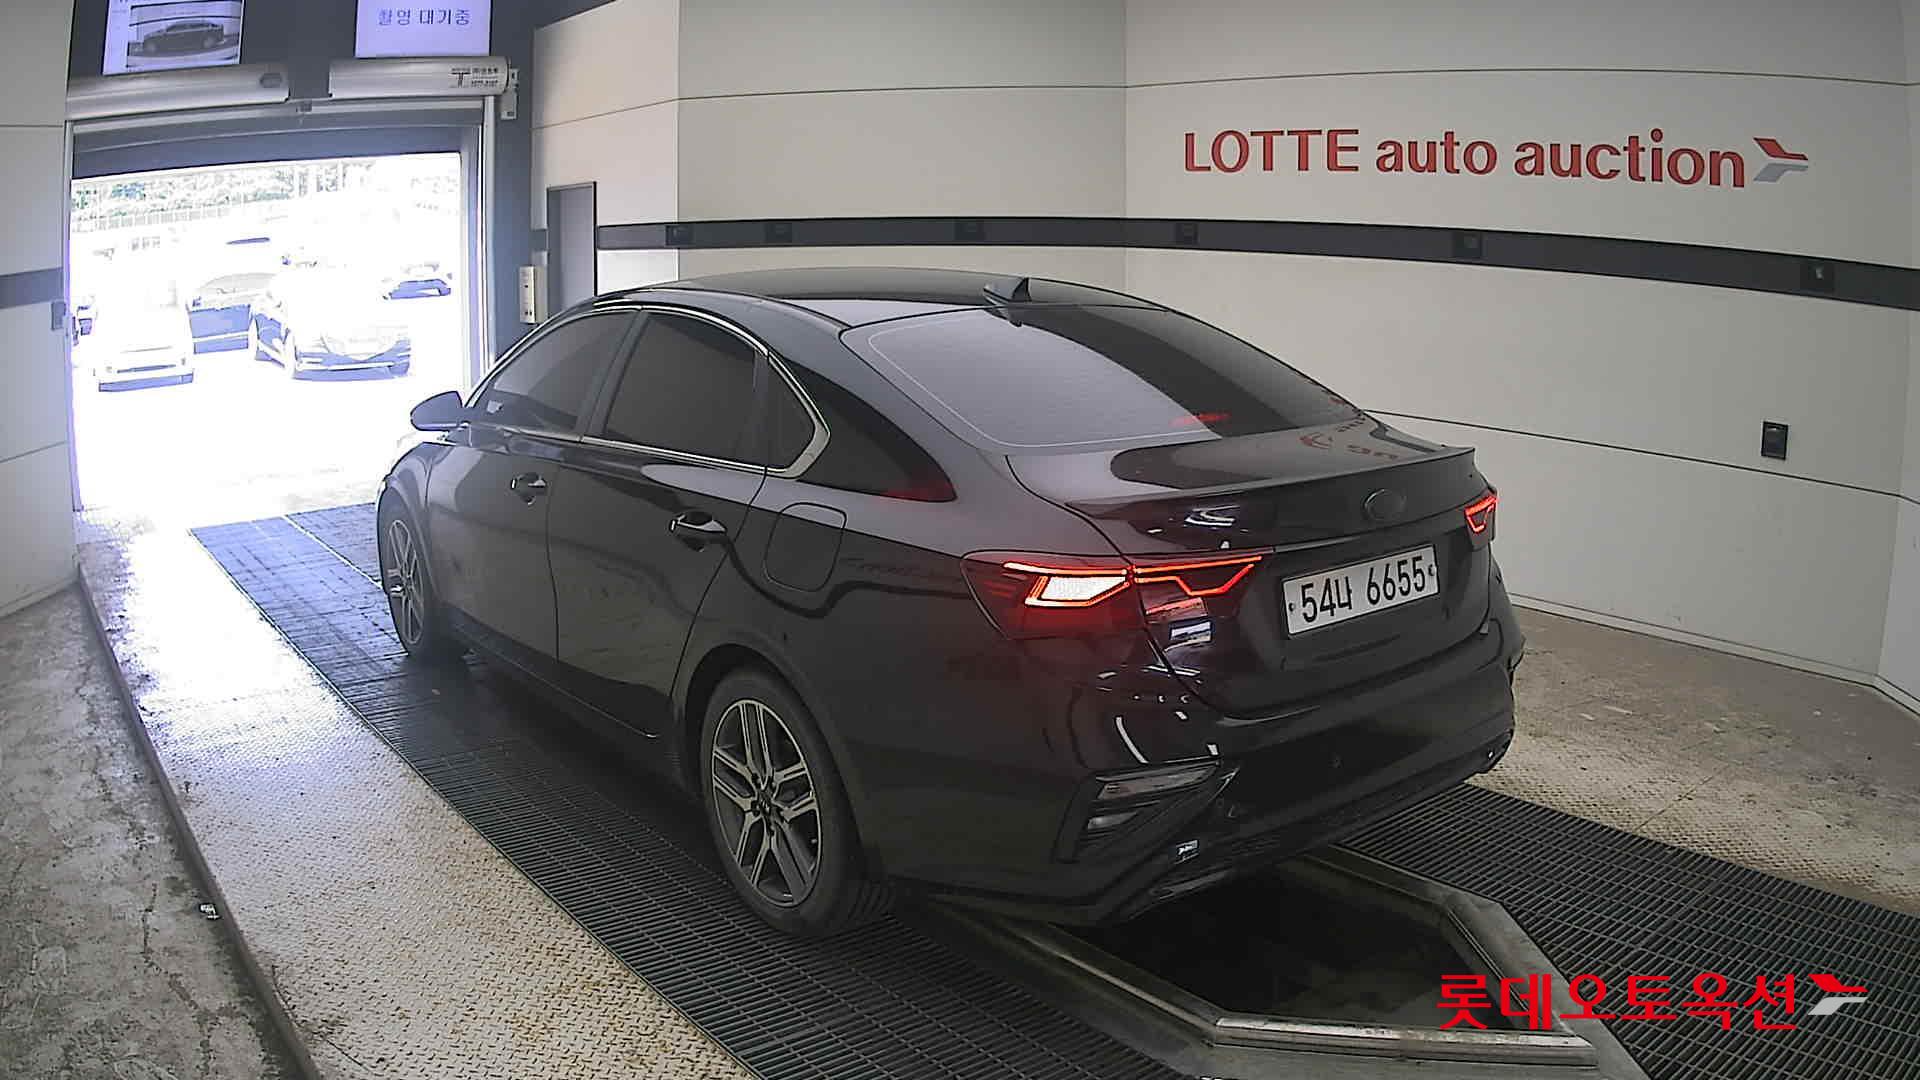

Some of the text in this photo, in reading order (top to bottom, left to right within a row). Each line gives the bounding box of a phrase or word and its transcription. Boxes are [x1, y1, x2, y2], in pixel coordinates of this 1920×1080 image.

[419, 8, 471, 26] 대기중
[1184, 128, 1745, 188] LOTTE auto auction
[1301, 556, 1426, 623] 54나 6655
